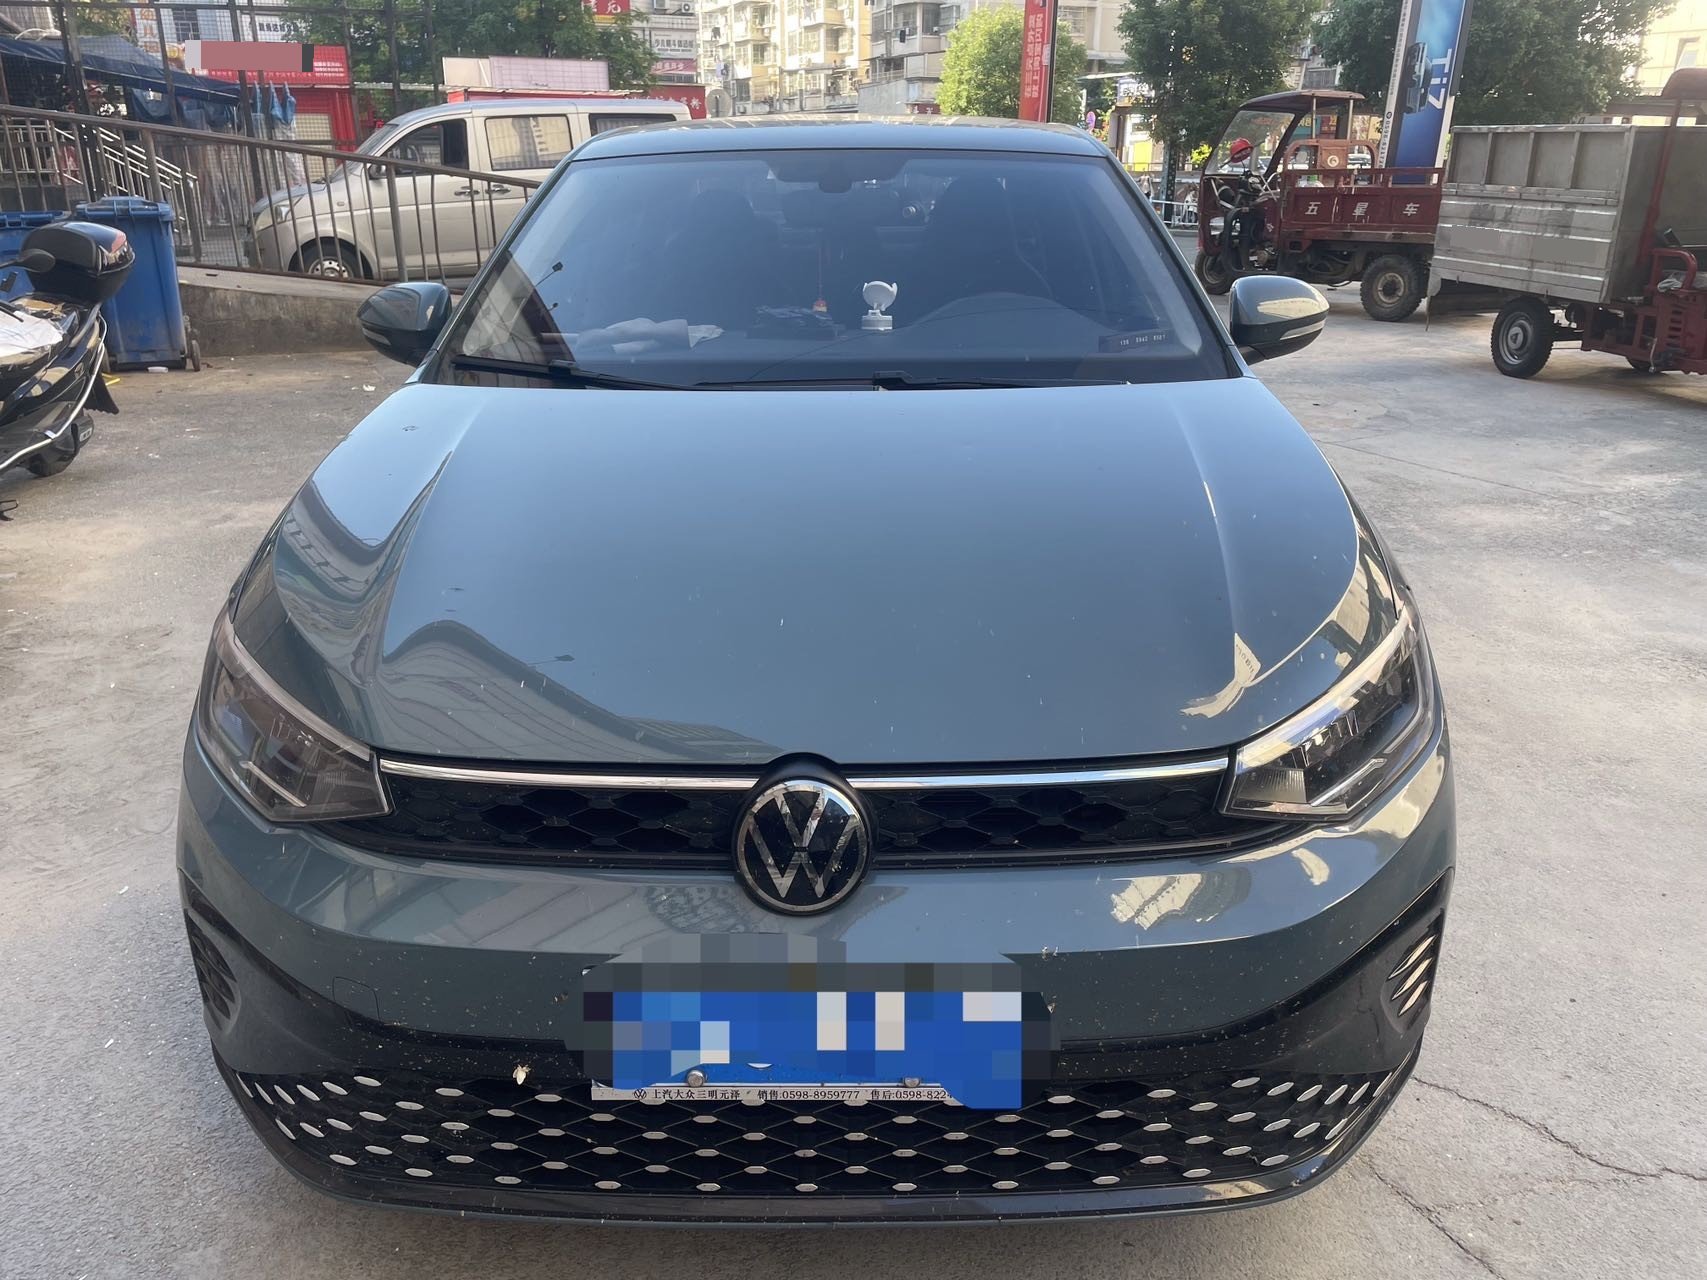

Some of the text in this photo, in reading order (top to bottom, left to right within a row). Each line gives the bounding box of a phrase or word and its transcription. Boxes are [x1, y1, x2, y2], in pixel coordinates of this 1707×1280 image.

[1428, 48, 1453, 109] Ti7
[1305, 201, 1420, 217] 五星车
[653, 1089, 741, 1100] 上汽大众三明元泽
[757, 1089, 860, 1100] 销售:0598-8959777
